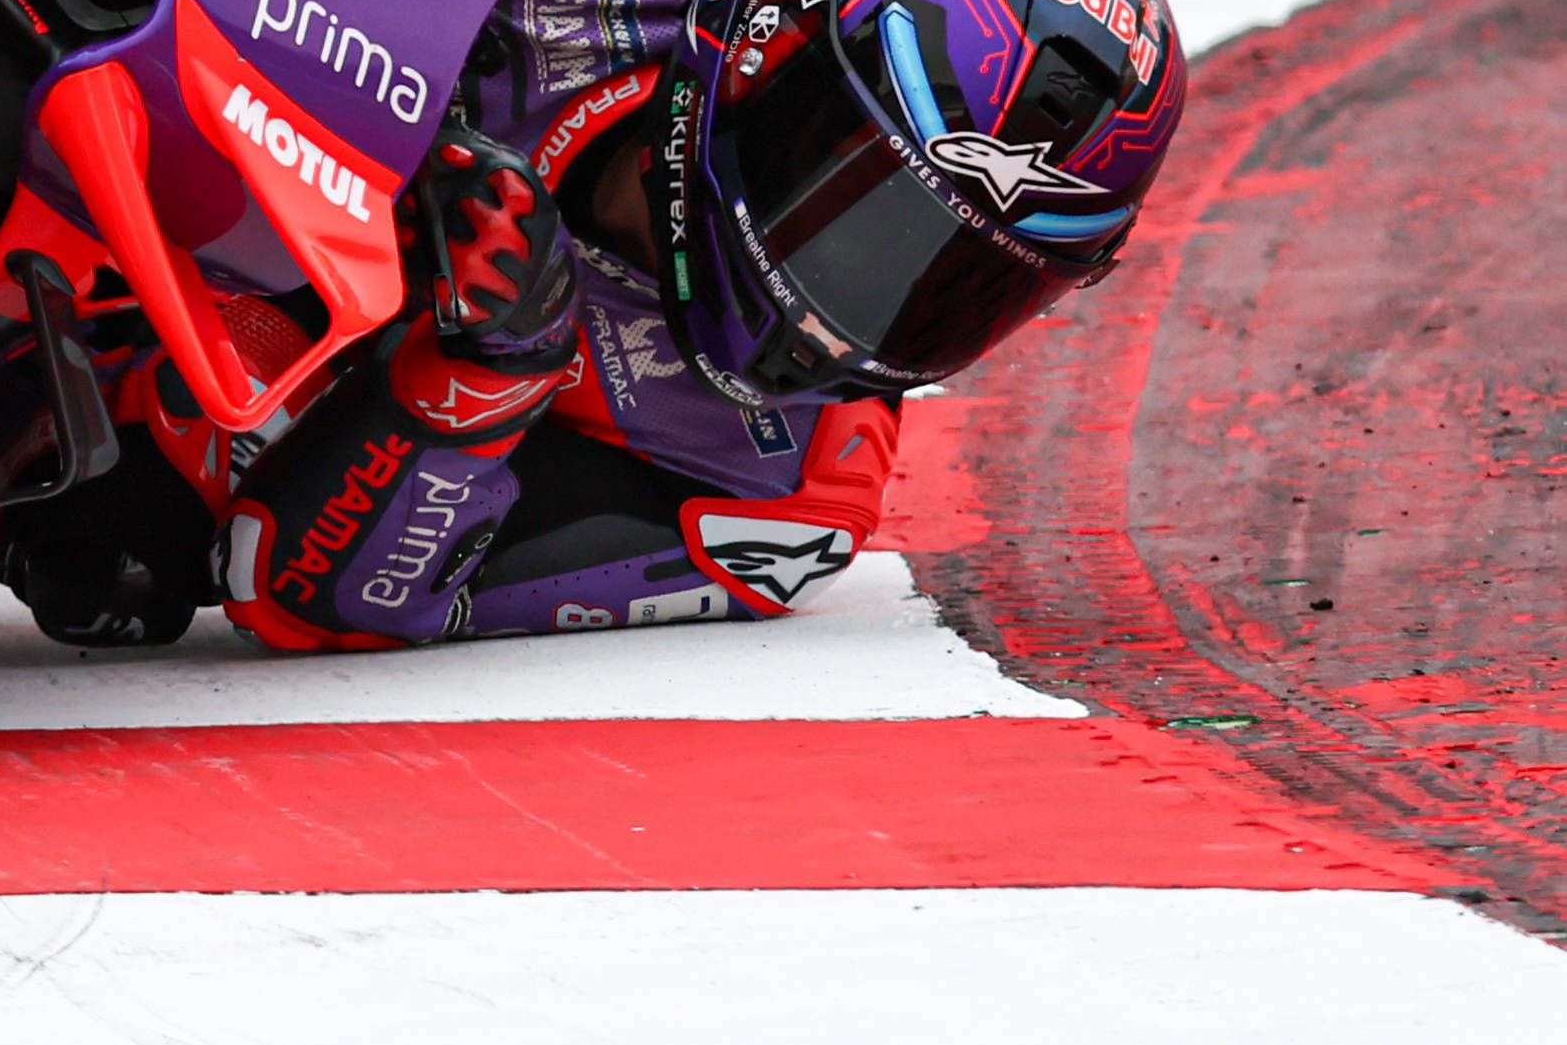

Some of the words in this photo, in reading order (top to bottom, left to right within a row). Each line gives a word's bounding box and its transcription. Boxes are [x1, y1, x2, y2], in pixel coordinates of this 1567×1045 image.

[222, 84, 371, 224] MOTUL
[537, 75, 641, 176] PRAMA
[665, 116, 691, 244] kyrrex
[738, 214, 770, 273] Breathe
[767, 270, 795, 308] Right
[889, 135, 941, 189] GIVES
[947, 192, 986, 229] YOU
[991, 229, 1047, 269] WINGS
[586, 305, 637, 411] PRAMAC
[361, 470, 475, 608] prima
